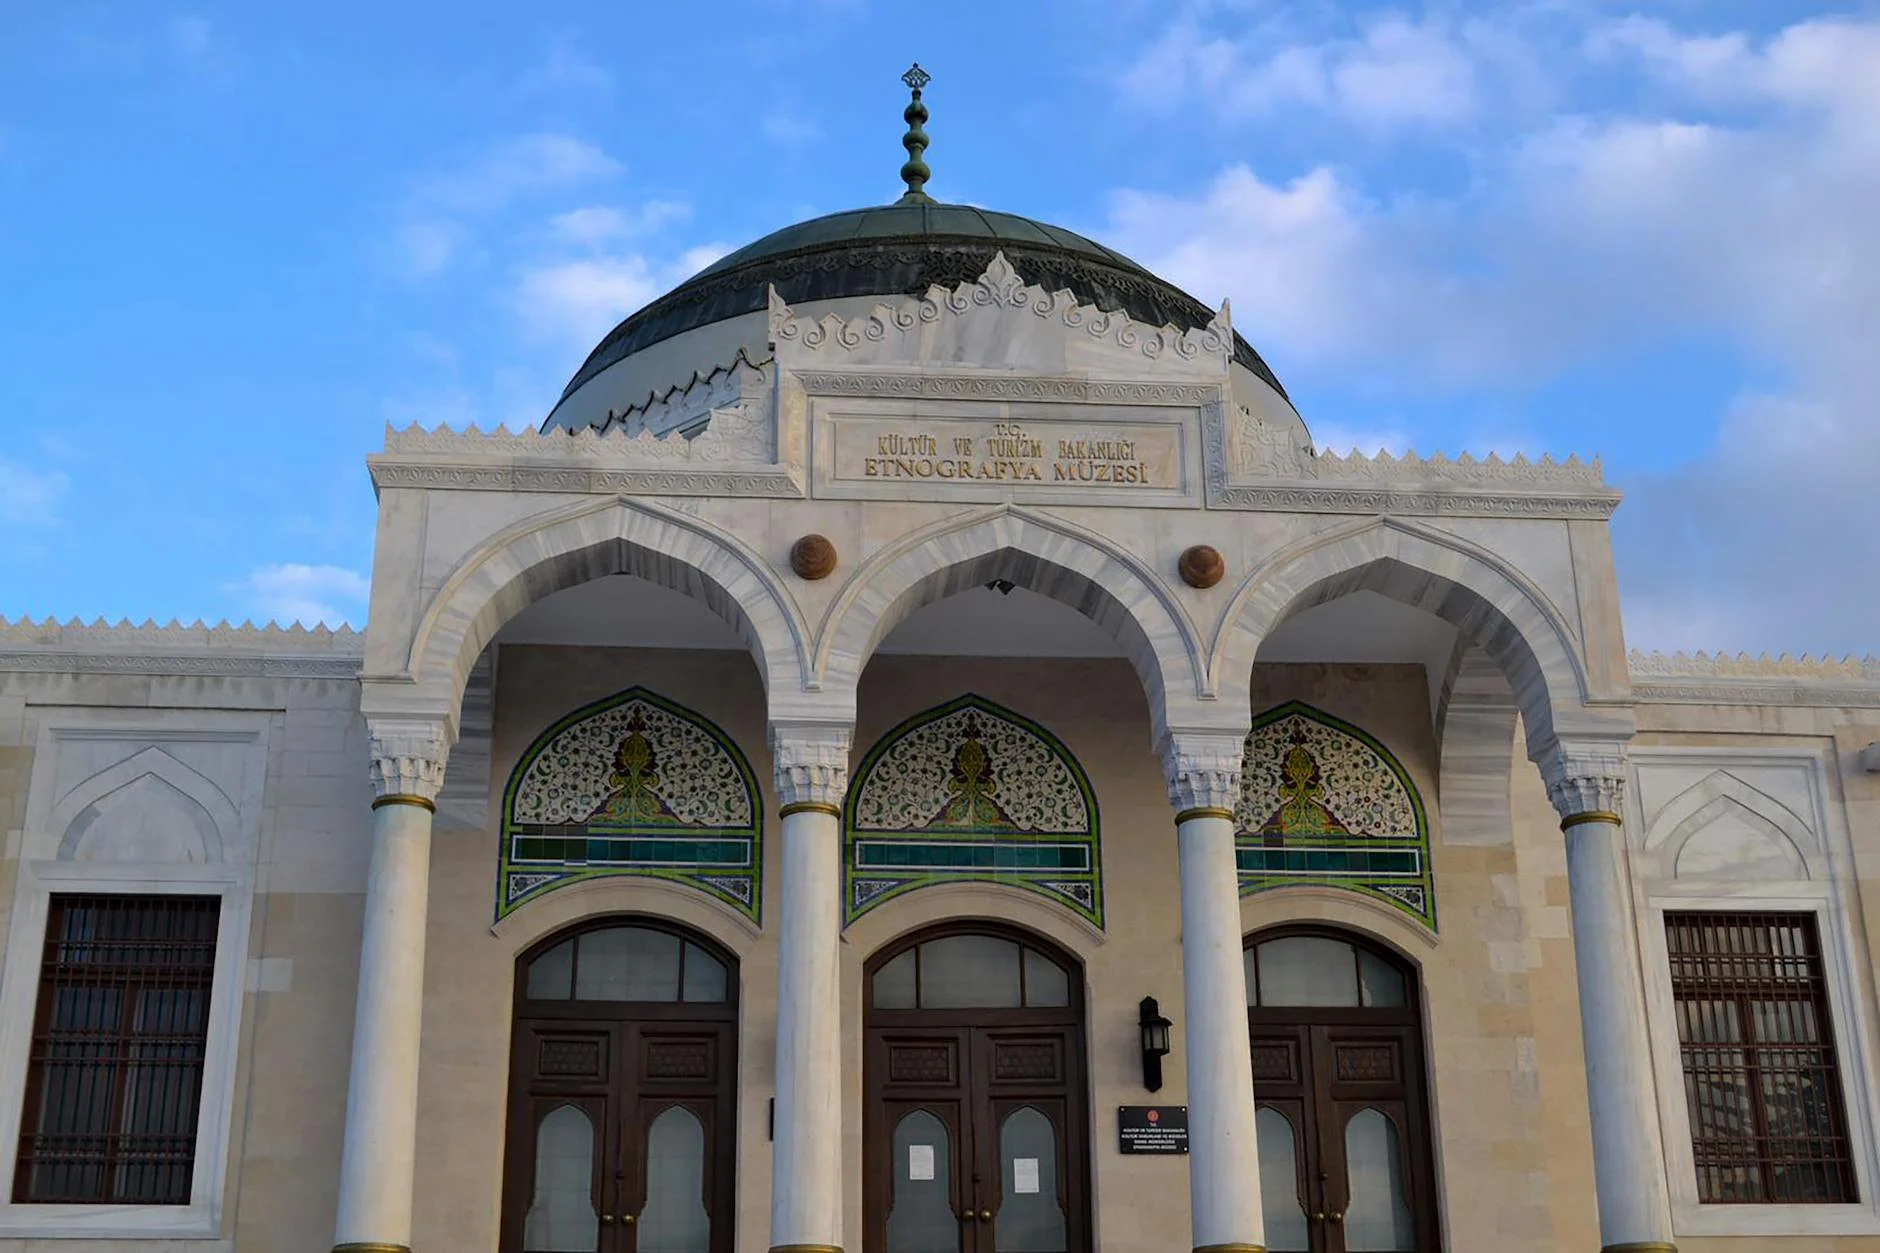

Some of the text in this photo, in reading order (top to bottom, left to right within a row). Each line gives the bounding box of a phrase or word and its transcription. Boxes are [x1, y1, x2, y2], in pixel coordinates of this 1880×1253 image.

[994, 424, 1027, 437] T.C.
[878, 434, 1136, 460] KÜLTÜR VE TURİZM BAKANLIĞI
[864, 458, 1149, 484] ETNOGRAFYA MÜZESİ
